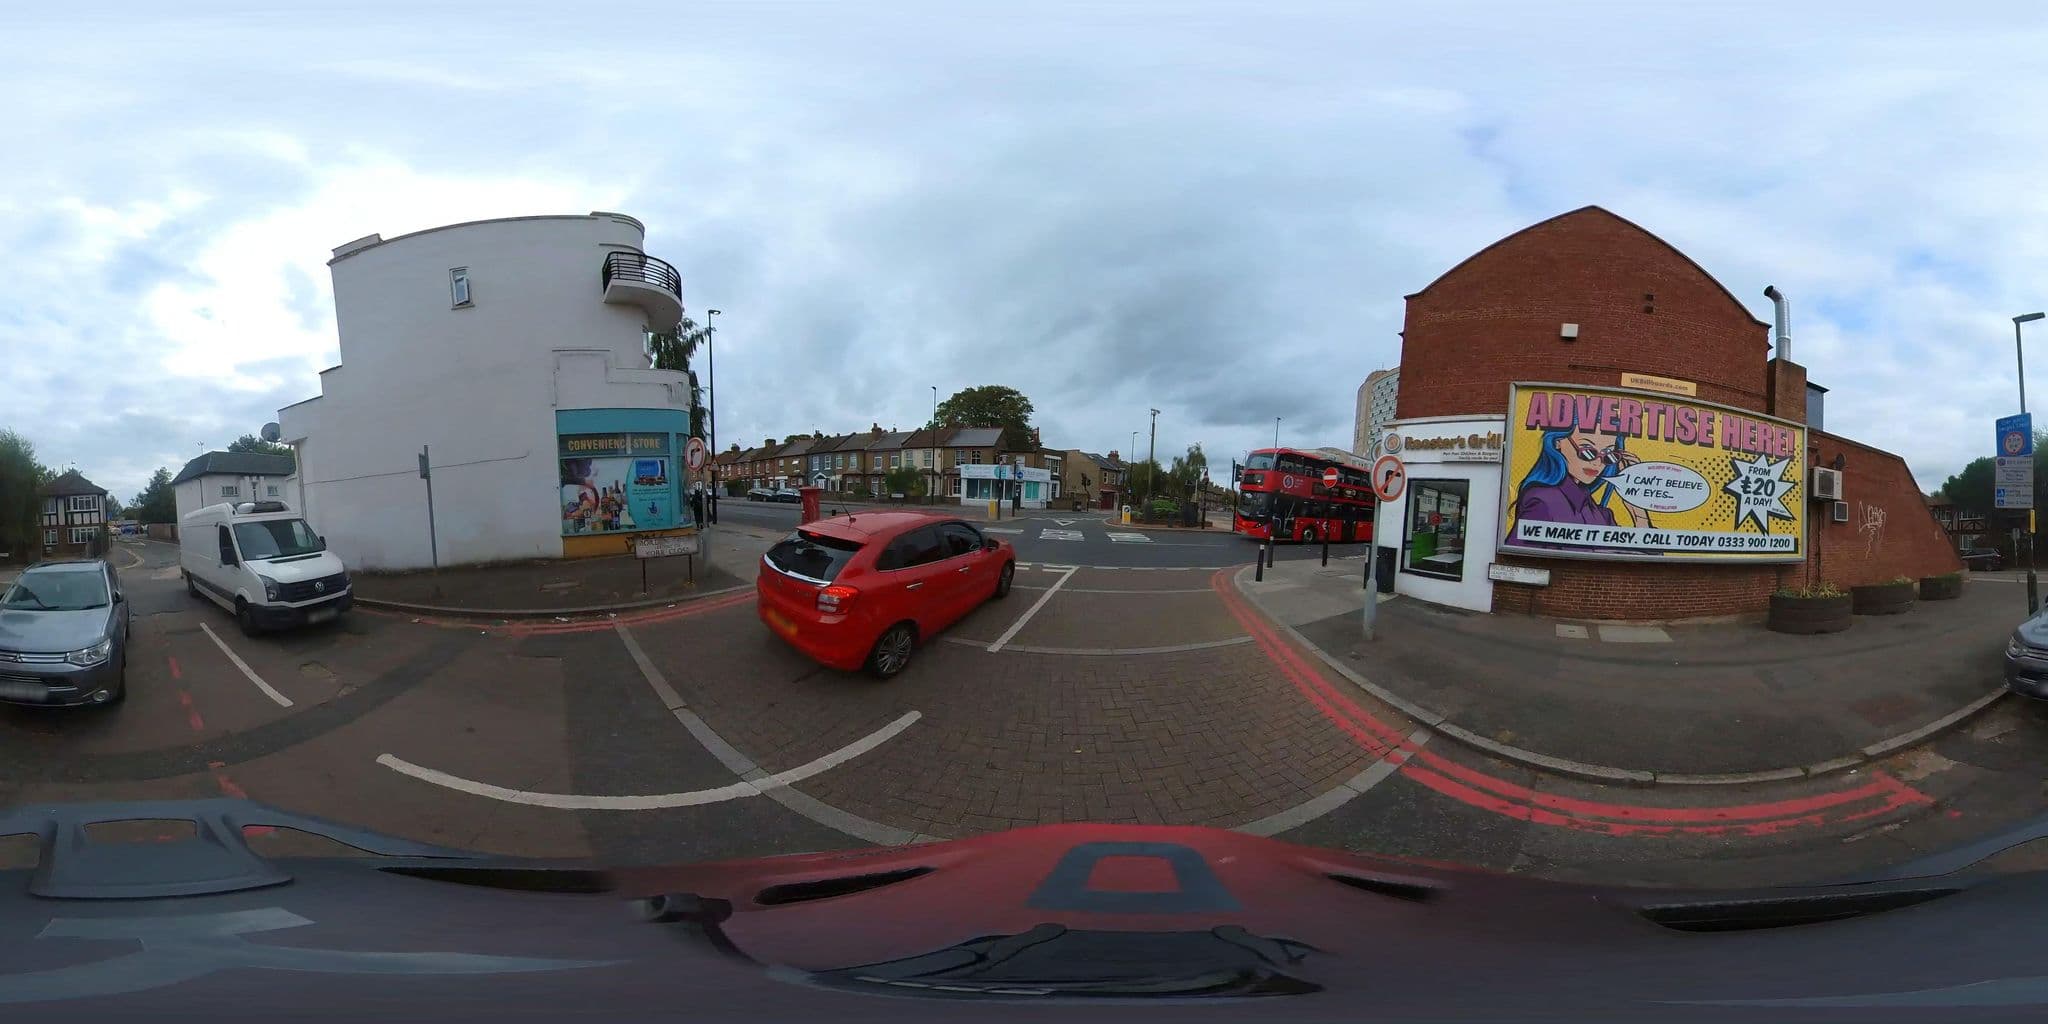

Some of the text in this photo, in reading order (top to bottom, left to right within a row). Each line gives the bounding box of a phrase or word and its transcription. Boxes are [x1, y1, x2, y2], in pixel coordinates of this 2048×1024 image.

[1526, 392, 1796, 457] ADVERTISE HERE!
[568, 438, 660, 451] CONVENIENC STORE
[1405, 430, 1502, 450] Rooster's Grill
[1748, 466, 1771, 476] FROM
[1625, 474, 1703, 490] I CAN'T BELIEVE
[1740, 475, 1776, 497] £20
[1625, 487, 1640, 496] MY
[1744, 496, 1772, 507] A DAY!
[1523, 525, 1790, 548] WE MAKE IT EASY. CALL TODAY 0333 900 1200
